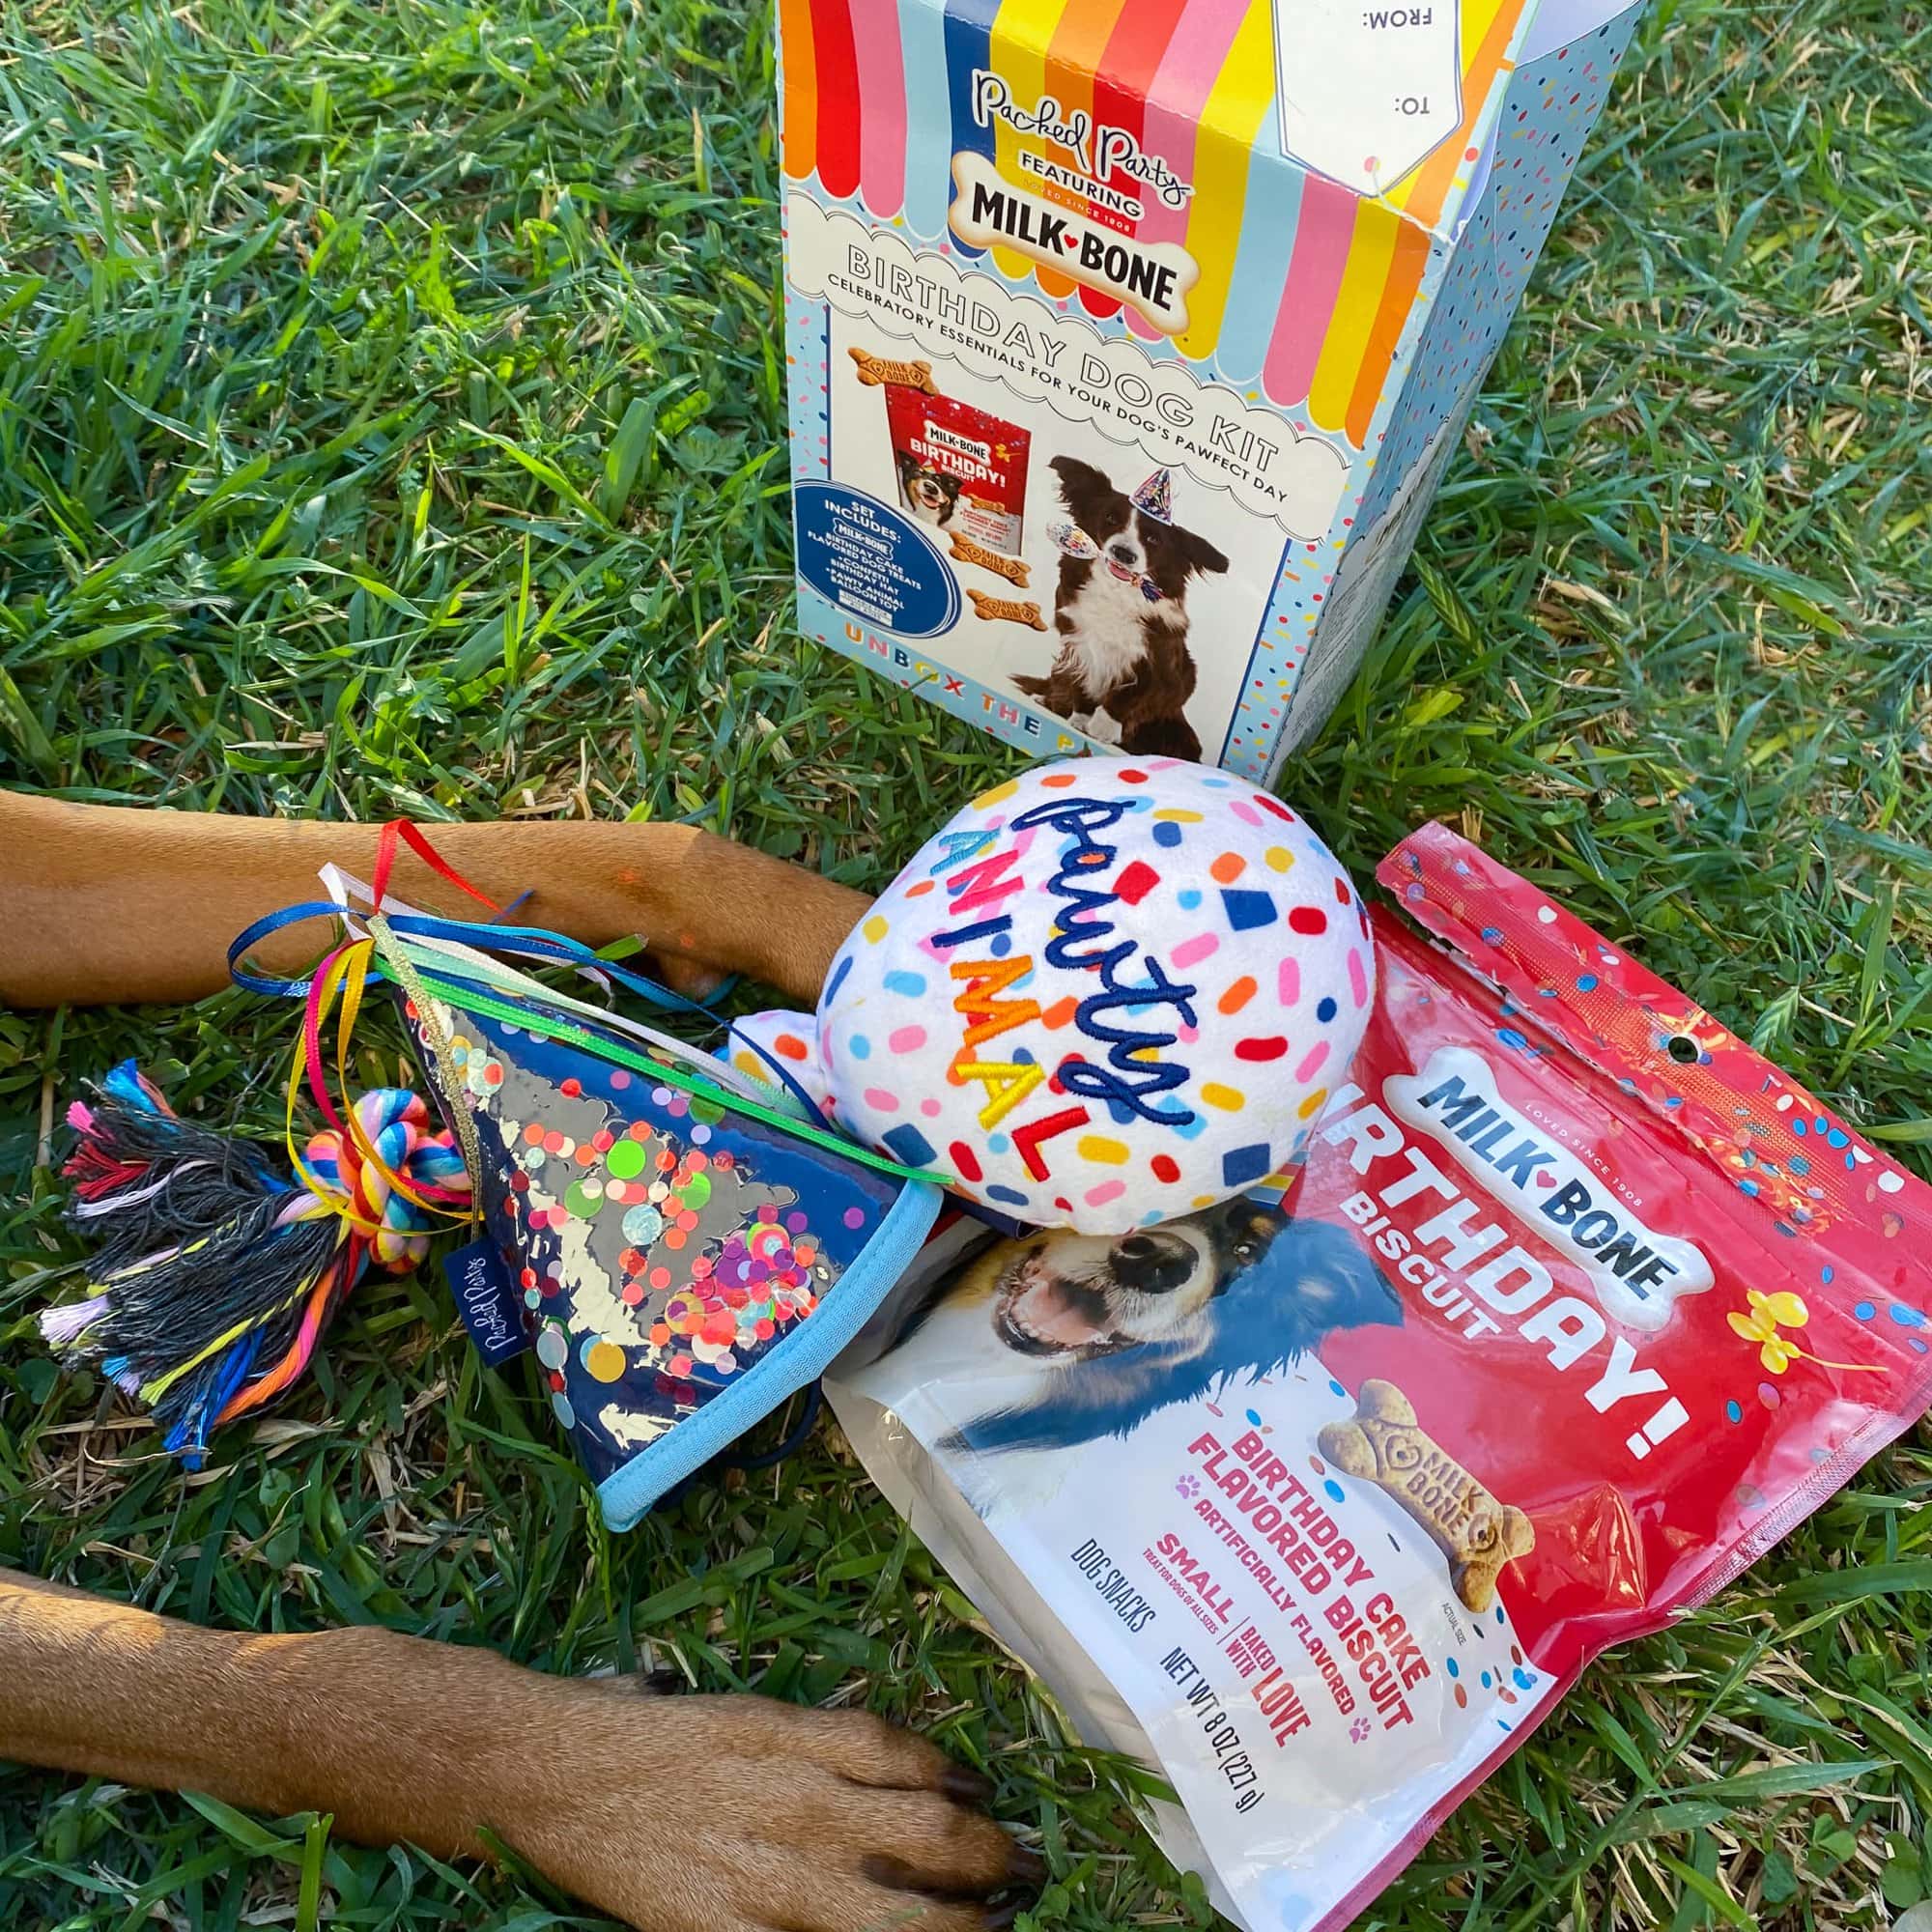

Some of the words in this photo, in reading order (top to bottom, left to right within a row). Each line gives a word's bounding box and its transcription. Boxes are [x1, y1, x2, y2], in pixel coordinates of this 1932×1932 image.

[1363, 8, 1432, 29] FROM:
[1395, 97, 1431, 115] TO:
[977, 73, 1088, 170] Packed
[1101, 128, 1191, 205] Party
[1022, 153, 1142, 217] FEATURING
[1065, 198, 1099, 217] SINCE
[848, 243, 1066, 369] BIRTHDAY
[1080, 353, 1194, 427] DOG
[1209, 414, 1279, 472] KIT
[828, 273, 934, 329] CELEBRATORY
[940, 324, 1026, 373] ESSENTIALS
[1031, 367, 1062, 389] FOR
[1067, 384, 1111, 412] YOUR
[1117, 408, 1170, 440] DOG'S
[1175, 436, 1250, 481] PAWFECT
[1252, 476, 1289, 503] DAY
[910, 438, 1006, 488] BIRTHDAY!
[941, 464, 976, 483] BISCUIT
[824, 499, 901, 544] INCLUDES:
[851, 501, 875, 519] SET
[808, 530, 859, 559] FLAVORED
[862, 555, 886, 573] DOG
[889, 569, 922, 591] TREATS
[826, 532, 873, 558] BIRTHDAY
[875, 555, 904, 575] CAKE
[831, 558, 876, 584] BIRTHDAY
[879, 582, 899, 596] HAT
[831, 576, 877, 602] BALLOON
[879, 598, 899, 611] TOY
[866, 584, 905, 610] ANIMAL
[845, 622, 965, 696] UNBOX
[981, 692, 1040, 736] THE
[929, 827, 1091, 1182] ANIMAL
[1525, 1103, 1568, 1137] LOVED
[1572, 1139, 1610, 1175] SINCE
[1612, 1177, 1642, 1207] 1908
[1339, 1190, 1502, 1340] BISCUIT
[1406, 1470, 1469, 1536] BONE
[1423, 1452, 1485, 1514] MILK
[1156, 1533, 1235, 1624] SMALL
[1187, 1432, 1332, 1596] FLAVORED
[1323, 1594, 1414, 1731] BISCUIT
[1231, 1430, 1376, 1588] BIRTHDAY
[1365, 1592, 1432, 1691] CAKE
[1070, 1538, 1112, 1581] DOG
[1095, 1569, 1157, 1634] SNACKS
[1143, 1548, 1163, 1570] TREAT
[1158, 1566, 1173, 1581] FOR
[1169, 1578, 1188, 1598] DOGS
[1183, 1595, 1195, 1605] OF
[1190, 1604, 1205, 1618] ALL
[1200, 1614, 1219, 1634] SIZES
[1194, 1498, 1297, 1612] ARTIFICIALLY
[1290, 1613, 1356, 1716] FLAVORED
[1239, 1626, 1277, 1672] BAKED
[1441, 1602, 1460, 1630] ACTUAL
[1455, 1629, 1467, 1646] SIZE
[1159, 1646, 1200, 1686] NET
[1186, 1677, 1220, 1718] WT
[1225, 1638, 1257, 1678] WITH
[1251, 1666, 1312, 1748] LOVE
[1204, 1712, 1228, 1733] 8
[1211, 1726, 1241, 1758] OZ
[1218, 1750, 1259, 1791] (227
[1235, 1789, 1265, 1814] g)
